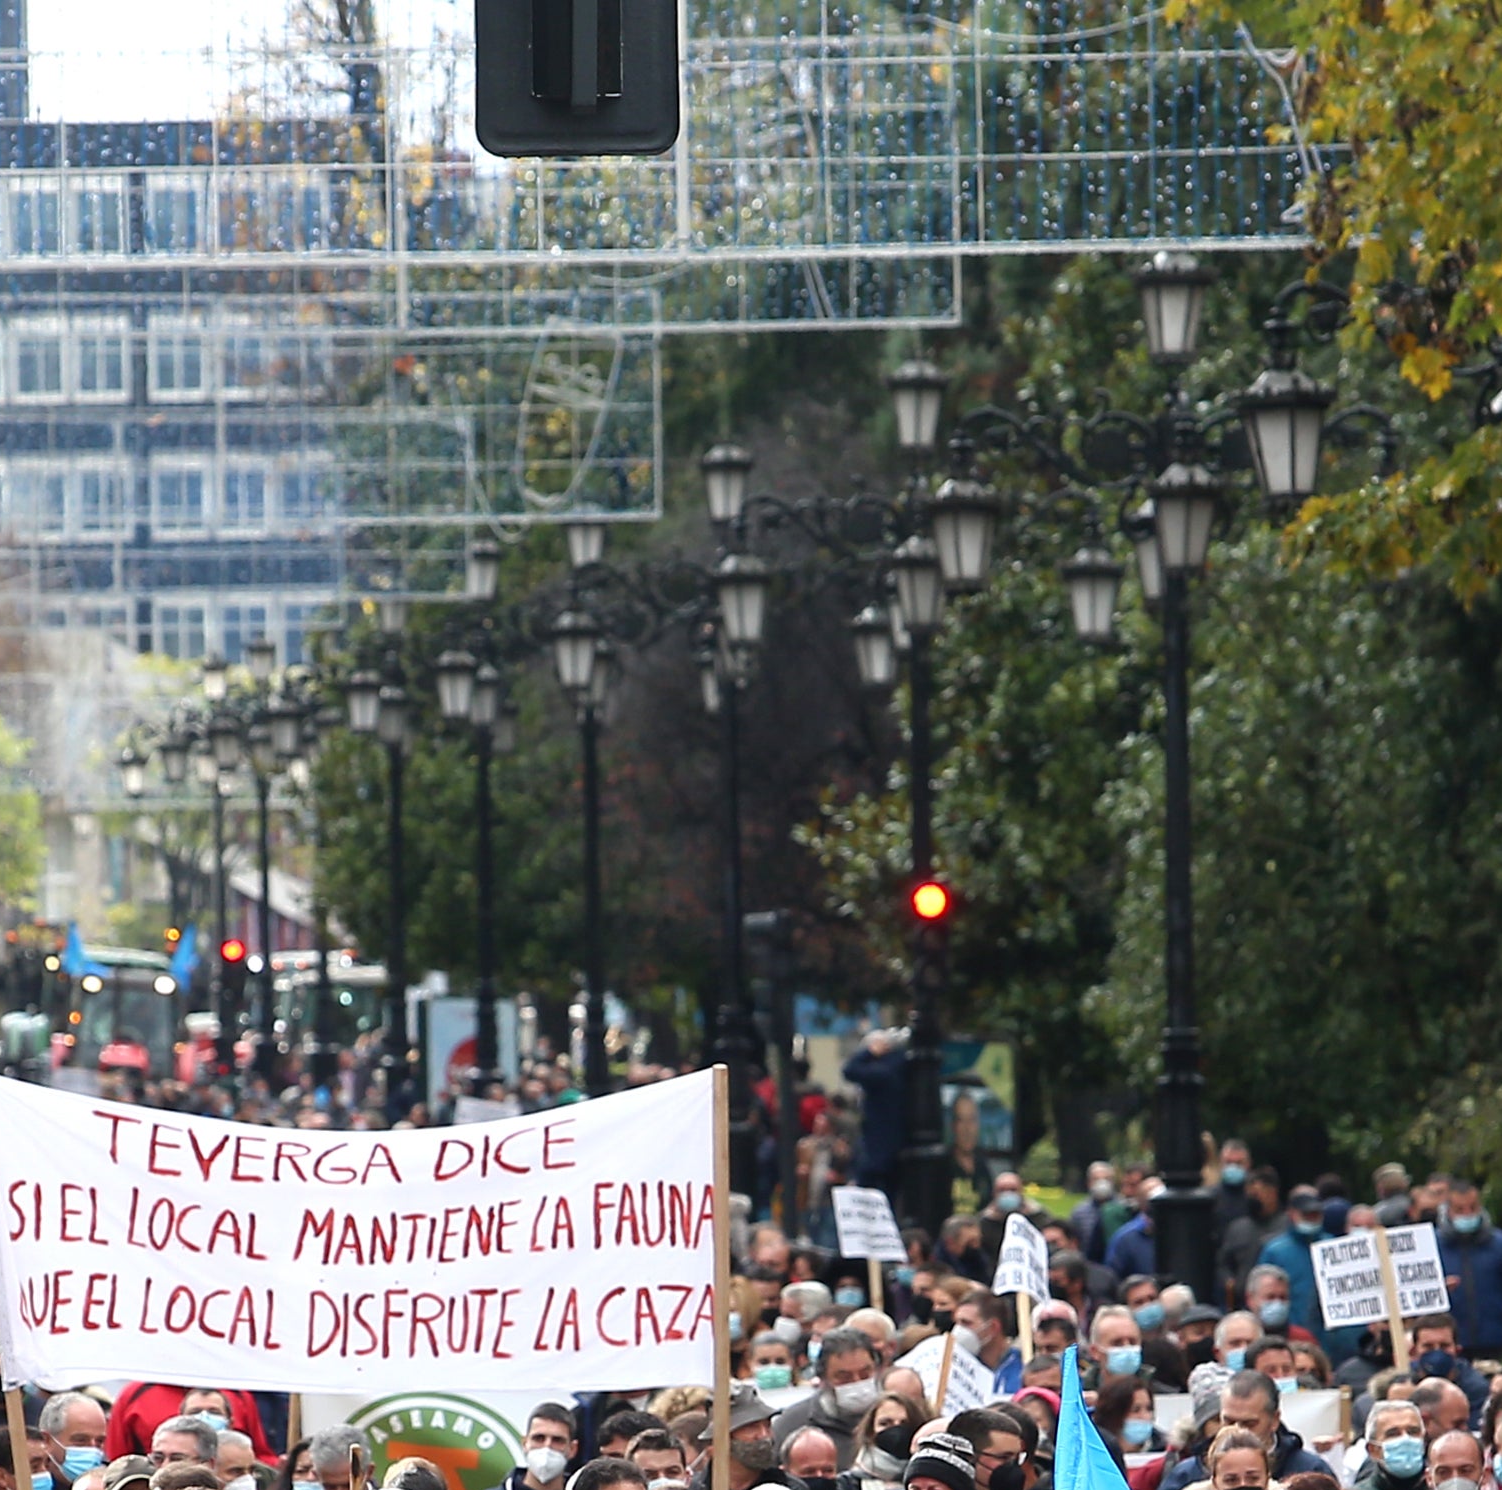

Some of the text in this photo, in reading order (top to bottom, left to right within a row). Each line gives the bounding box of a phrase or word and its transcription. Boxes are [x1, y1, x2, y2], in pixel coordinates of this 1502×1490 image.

[93, 1110, 576, 1185] TEVERGA DICE
[8, 1180, 714, 1265] SI EL LOCAL MANTIENE LA FAUNA
[82, 1273, 121, 1330] EL
[140, 1277, 281, 1350] LOCAL
[306, 1288, 522, 1360] DISFRUTE
[533, 1287, 580, 1351] LA
[597, 1284, 714, 1346] CAZA
[1327, 1269, 1384, 1296] FUNCIONAR
